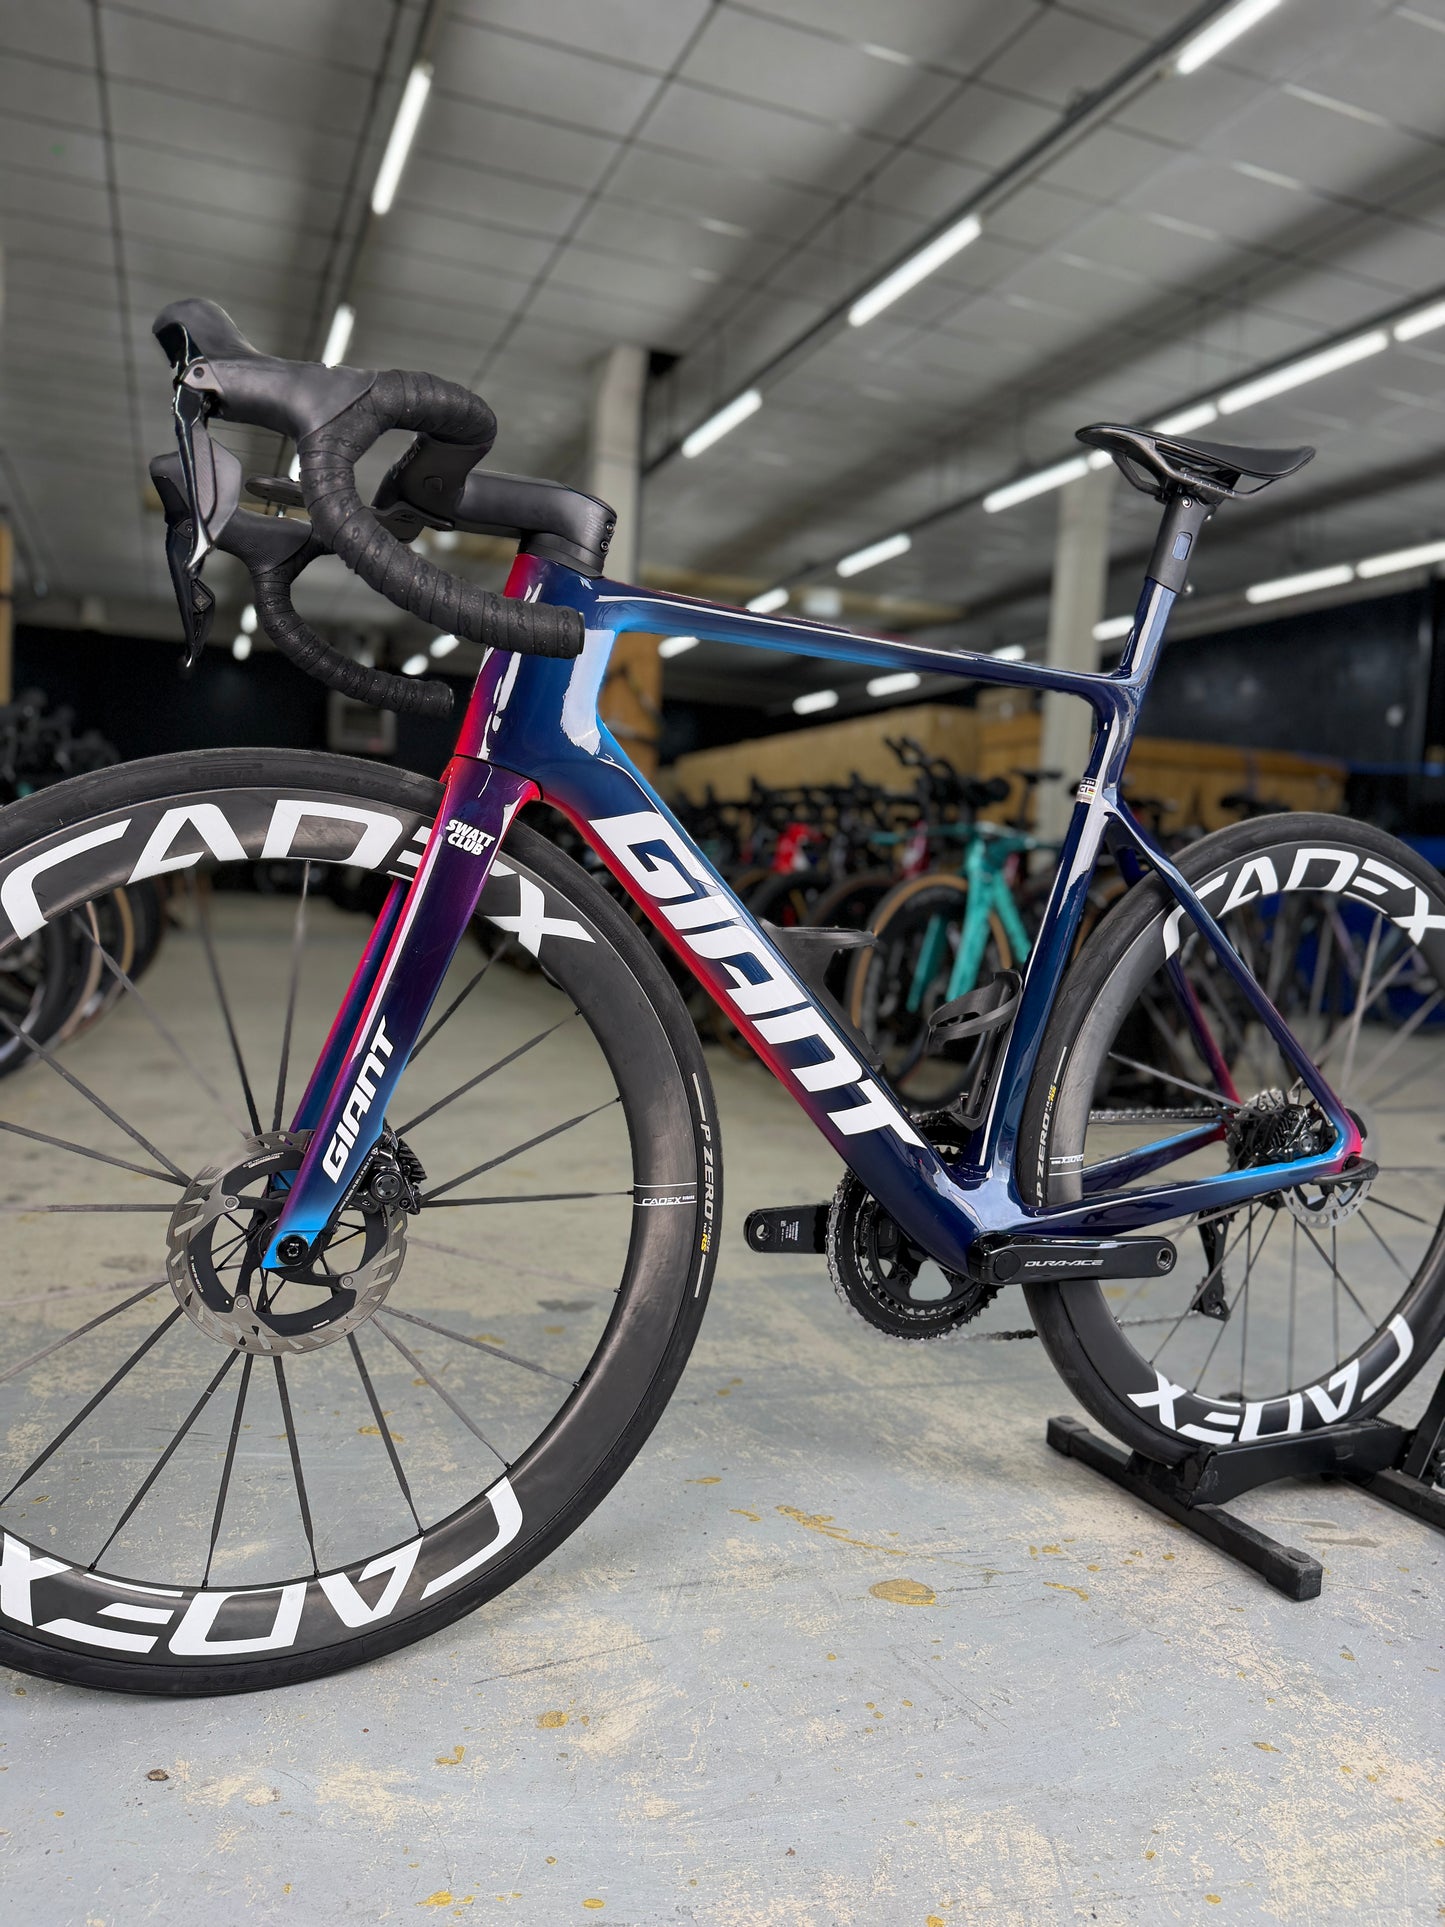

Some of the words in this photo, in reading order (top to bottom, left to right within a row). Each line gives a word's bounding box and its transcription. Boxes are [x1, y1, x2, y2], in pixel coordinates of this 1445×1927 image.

[445, 819, 496, 848] SWATT
[447, 833, 485, 856] CLUB
[1163, 848, 1445, 960] CADEX
[588, 811, 927, 1149] GIANT
[321, 1014, 394, 1184] GIANT
[700, 1123, 711, 1142] P
[1037, 1112, 1051, 1178] ZERO
[642, 1196, 681, 1205] CADEX
[703, 1146, 714, 1220] ZERO
[1036, 1181, 1043, 1198] P
[1024, 1259, 1104, 1267] DURA-ACE
[1127, 1314, 1414, 1444] CADEX
[0, 1476, 524, 1656] CADEX
